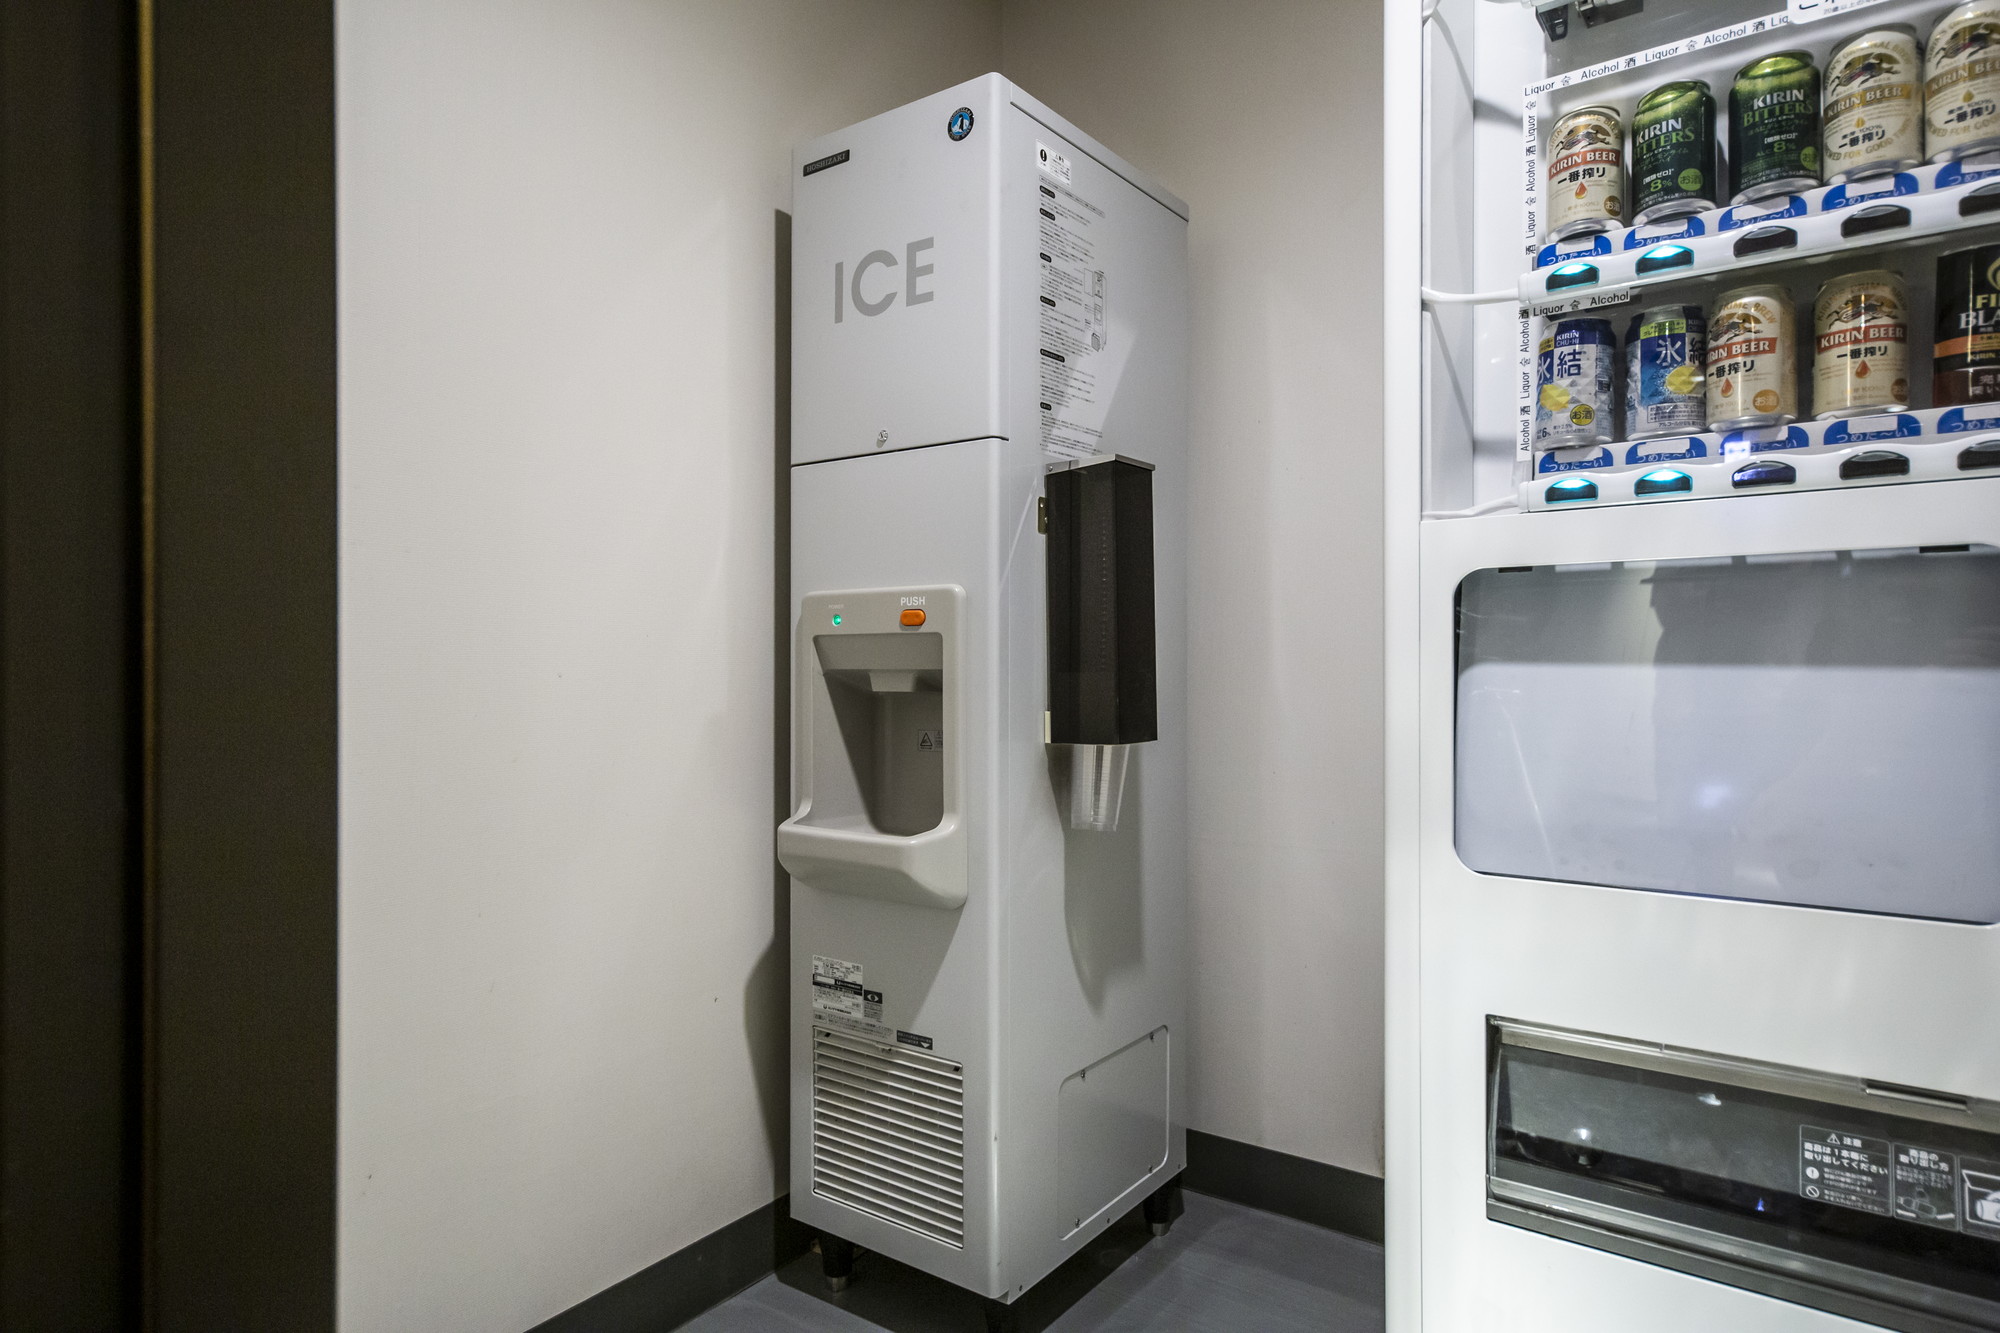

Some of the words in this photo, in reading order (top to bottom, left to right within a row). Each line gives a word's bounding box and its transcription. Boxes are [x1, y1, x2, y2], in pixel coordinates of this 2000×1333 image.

[1524, 81, 1556, 97] Liquor
[1580, 62, 1620, 80] Alcohol
[1623, 56, 1637, 69] 酒
[1645, 46, 1679, 63] Liquor
[1703, 25, 1747, 46] Alcohol
[1752, 19, 1766, 33] 酒
[1931, 69, 1969, 92] KIRIN
[1753, 89, 1804, 111] KIRIN
[1827, 93, 1862, 117] KIRIN
[1866, 86, 1904, 101] BEER
[1743, 101, 1814, 127] BITTERS
[1944, 103, 1997, 125] 一番搾り
[1525, 115, 1537, 143] Liquor
[1636, 117, 1683, 147] KIRIN
[1838, 129, 1886, 149] 一番搾り
[1525, 145, 1537, 157] 酒
[1636, 126, 1696, 158] ITTERS
[1551, 154, 1583, 175] KIRIN
[1586, 151, 1617, 163] BEER
[1525, 159, 1535, 191] Alcohol
[1557, 167, 1606, 185] 一番搾り
[1650, 178, 1673, 192] 8%
[1679, 174, 1702, 186] お酒
[1525, 211, 1537, 239] Liquor
[1525, 244, 1537, 256] 酒
[834, 236, 934, 324] ICE
[1518, 308, 1530, 320] 酒
[1533, 303, 1564, 318] Liquor
[1589, 291, 1629, 306] Alcohol
[1519, 320, 1530, 352] Alcohol
[1556, 330, 1580, 341] KIRIN
[1820, 329, 1864, 348] KIRIN
[1869, 326, 1904, 339] BEER
[1707, 347, 1728, 363] IRIN
[1732, 340, 1770, 356] BEER
[1836, 345, 1888, 360] 一番搾り
[1708, 359, 1755, 379] 一番搾り
[1520, 371, 1531, 399] Liquor
[1519, 405, 1531, 416] 酒
[1754, 396, 1777, 406] お酒
[1572, 409, 1593, 420] お酒
[1520, 419, 1530, 452] Alcohol
[900, 596, 926, 606] PUSH
[1843, 1136, 1862, 1148] 注意
[1803, 1150, 1889, 1175] 取り出してください
[1898, 1153, 1949, 1172] 取り出し方
